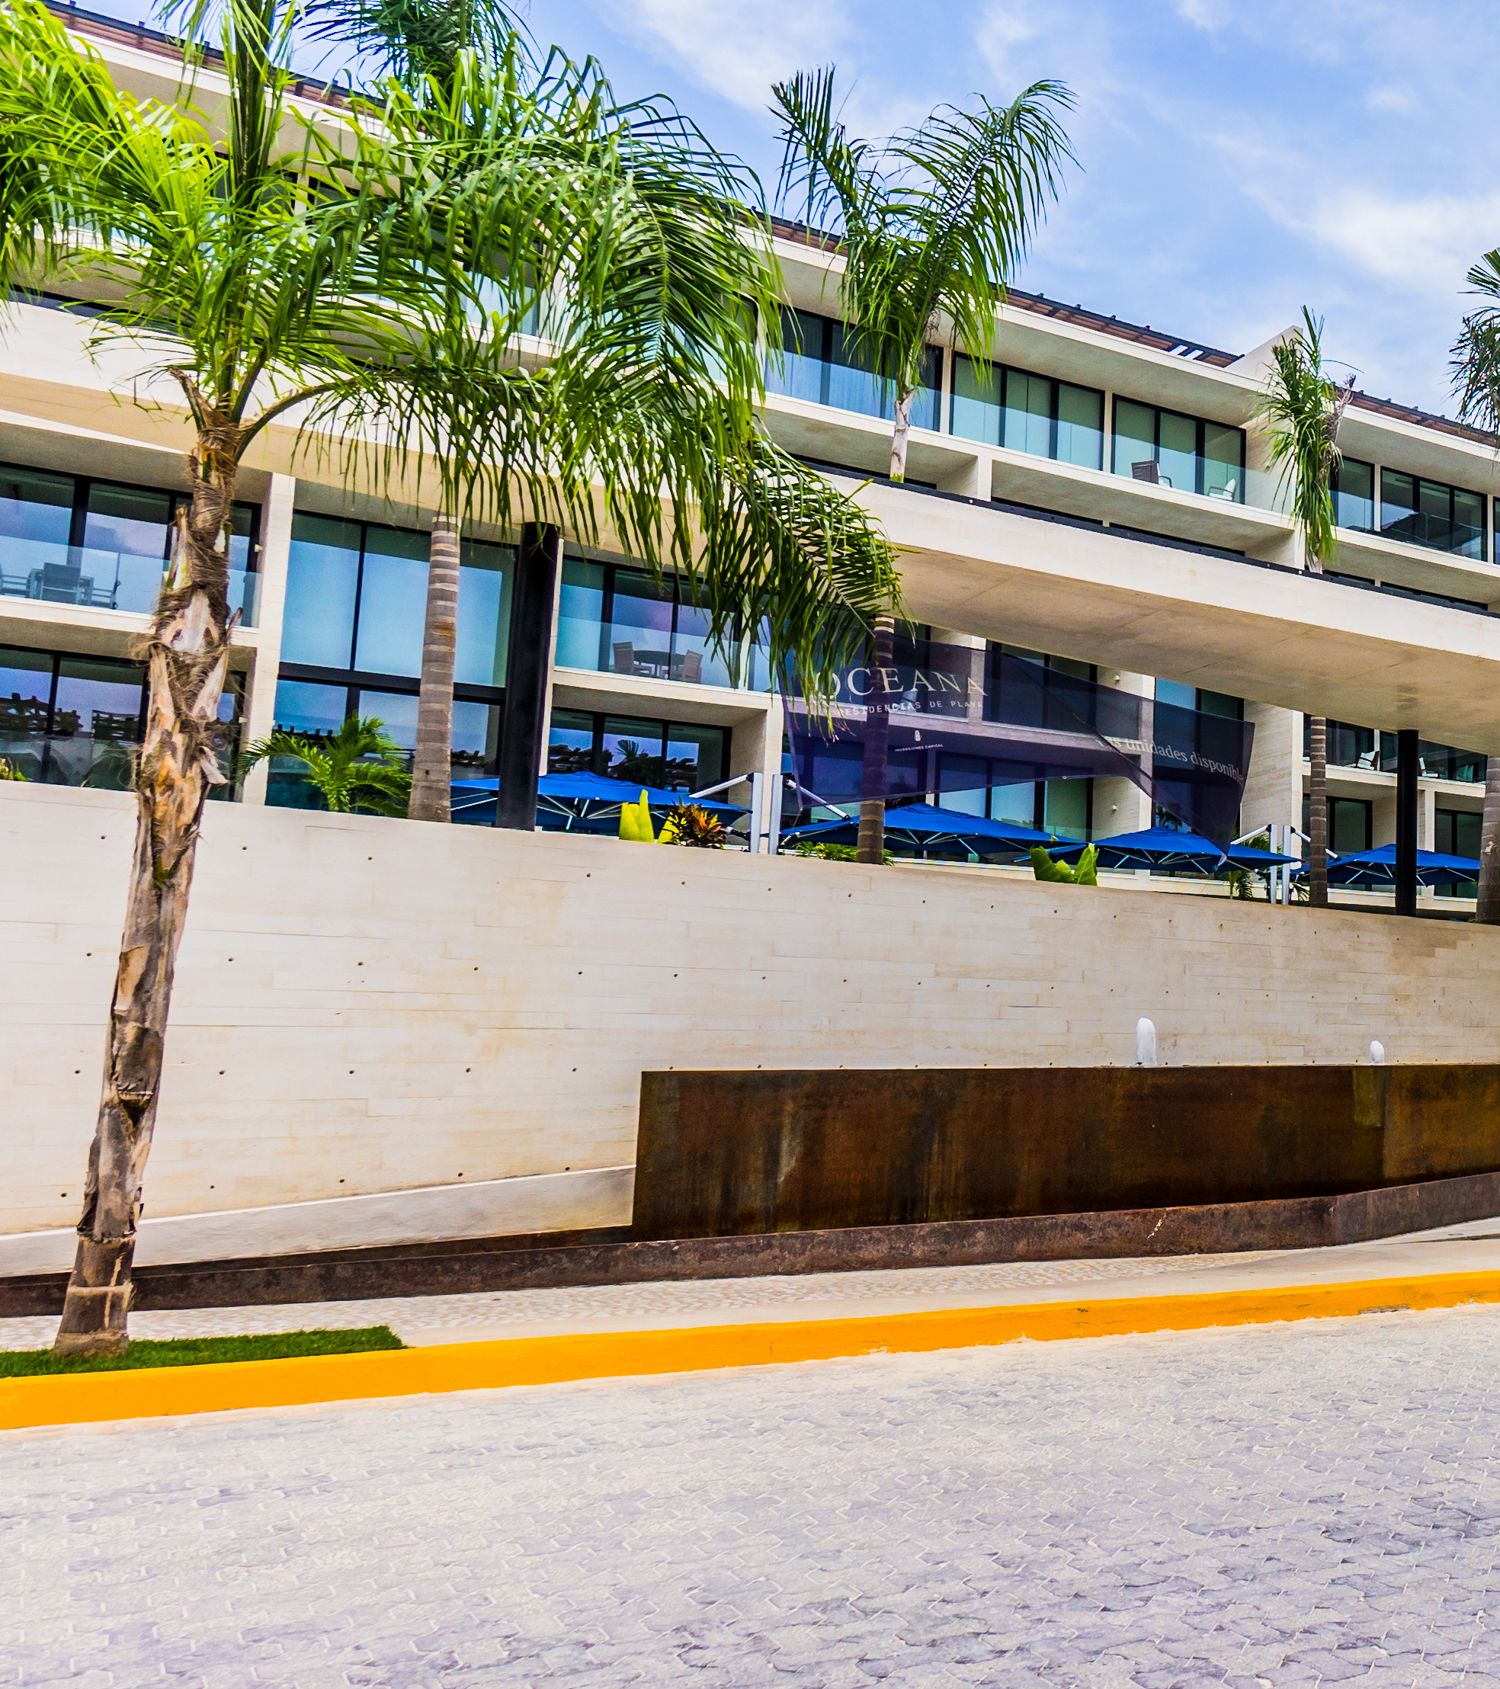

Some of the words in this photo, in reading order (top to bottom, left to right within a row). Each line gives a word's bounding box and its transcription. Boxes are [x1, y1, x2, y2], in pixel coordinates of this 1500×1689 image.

[816, 667, 988, 699] OCEANA
[930, 700, 943, 709] DE
[1126, 740, 1188, 763] unidades
